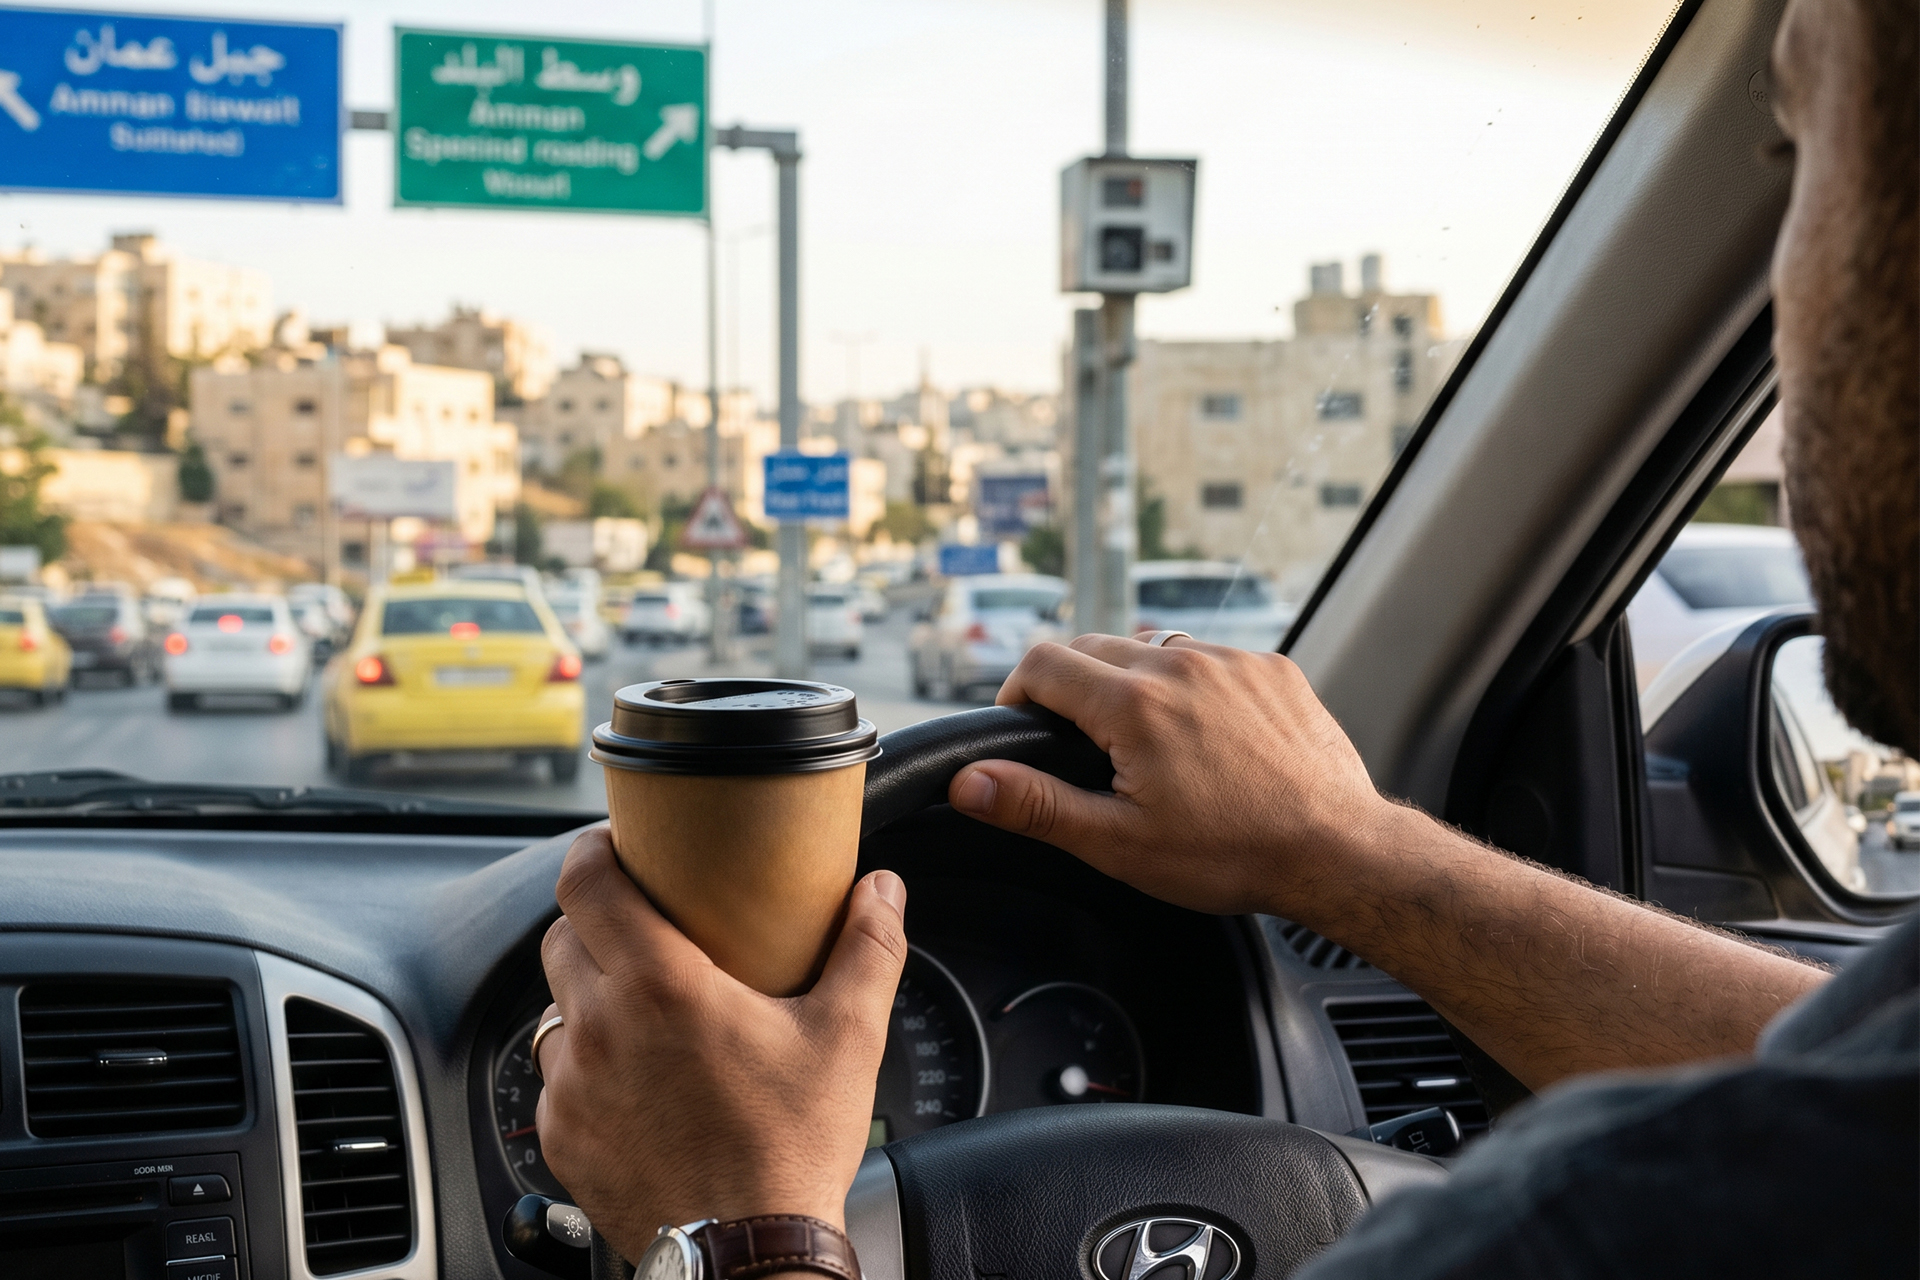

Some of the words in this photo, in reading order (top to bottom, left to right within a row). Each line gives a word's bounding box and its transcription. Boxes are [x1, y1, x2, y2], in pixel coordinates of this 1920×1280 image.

[50, 83, 175, 120] Amman
[468, 98, 586, 132] Amman
[509, 1086, 520, 1102] 2
[524, 1148, 536, 1164] 0
